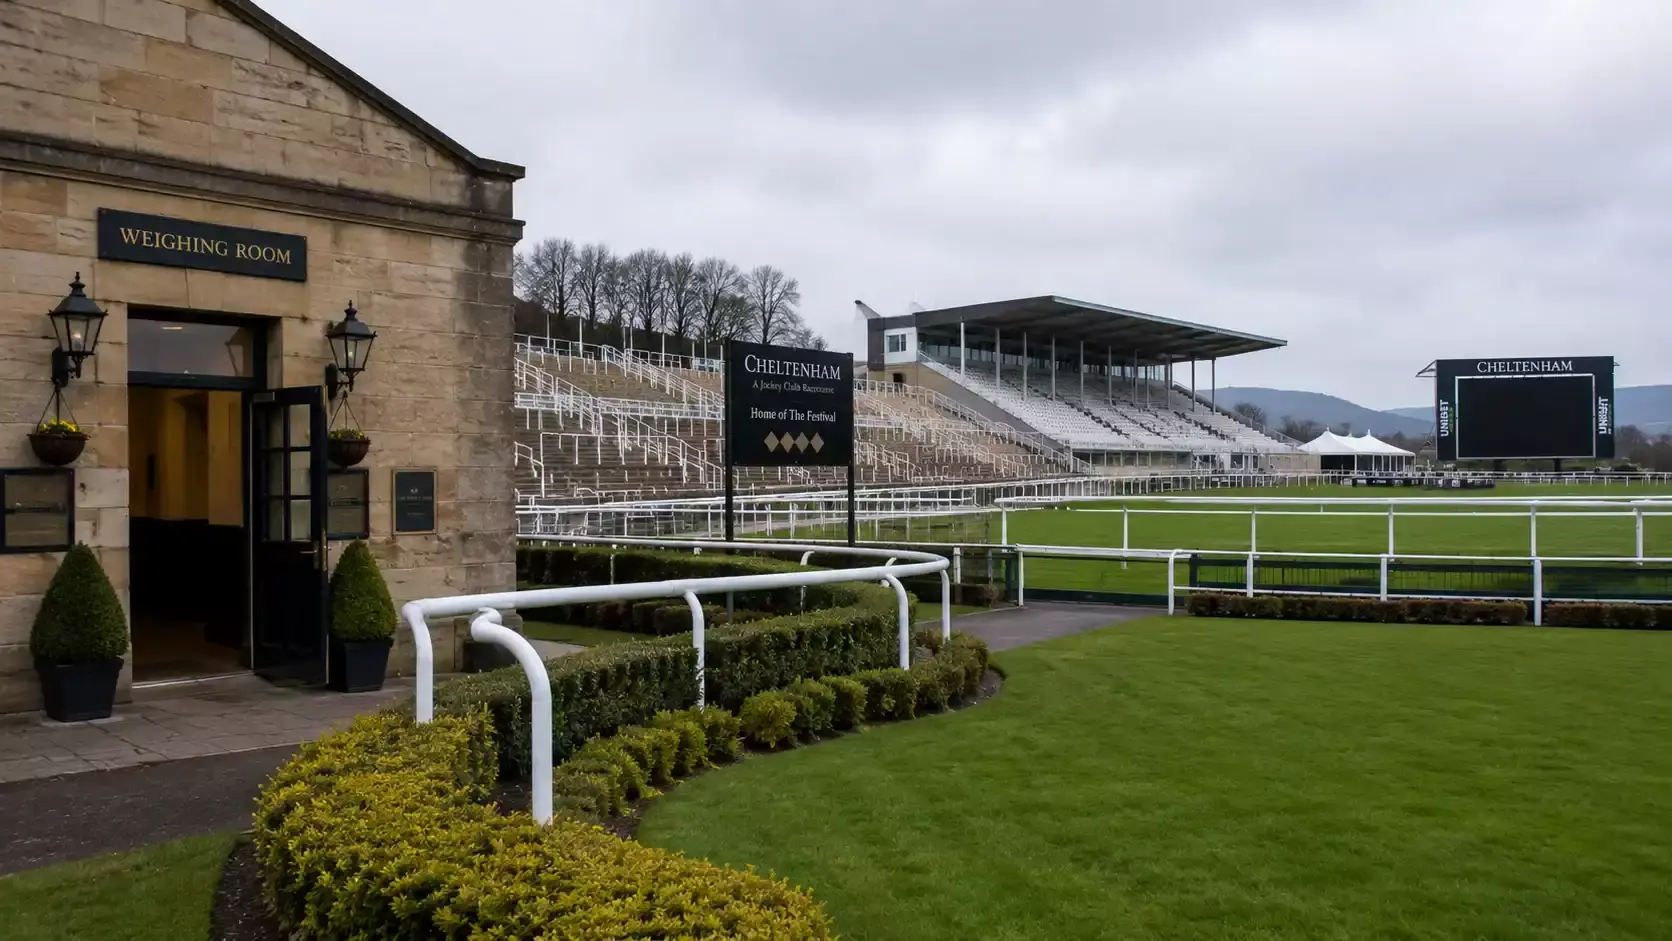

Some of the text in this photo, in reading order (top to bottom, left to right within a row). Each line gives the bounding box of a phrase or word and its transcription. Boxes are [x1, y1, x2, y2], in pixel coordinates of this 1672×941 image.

[119, 227, 292, 265] WEIGHING ROOM
[744, 354, 841, 380] CHELTENHAM
[1476, 360, 1573, 373] CHELTENHAM
[752, 380, 759, 389] A
[750, 407, 836, 422] Home of The Festival
[1440, 399, 1449, 437] UNIBET
